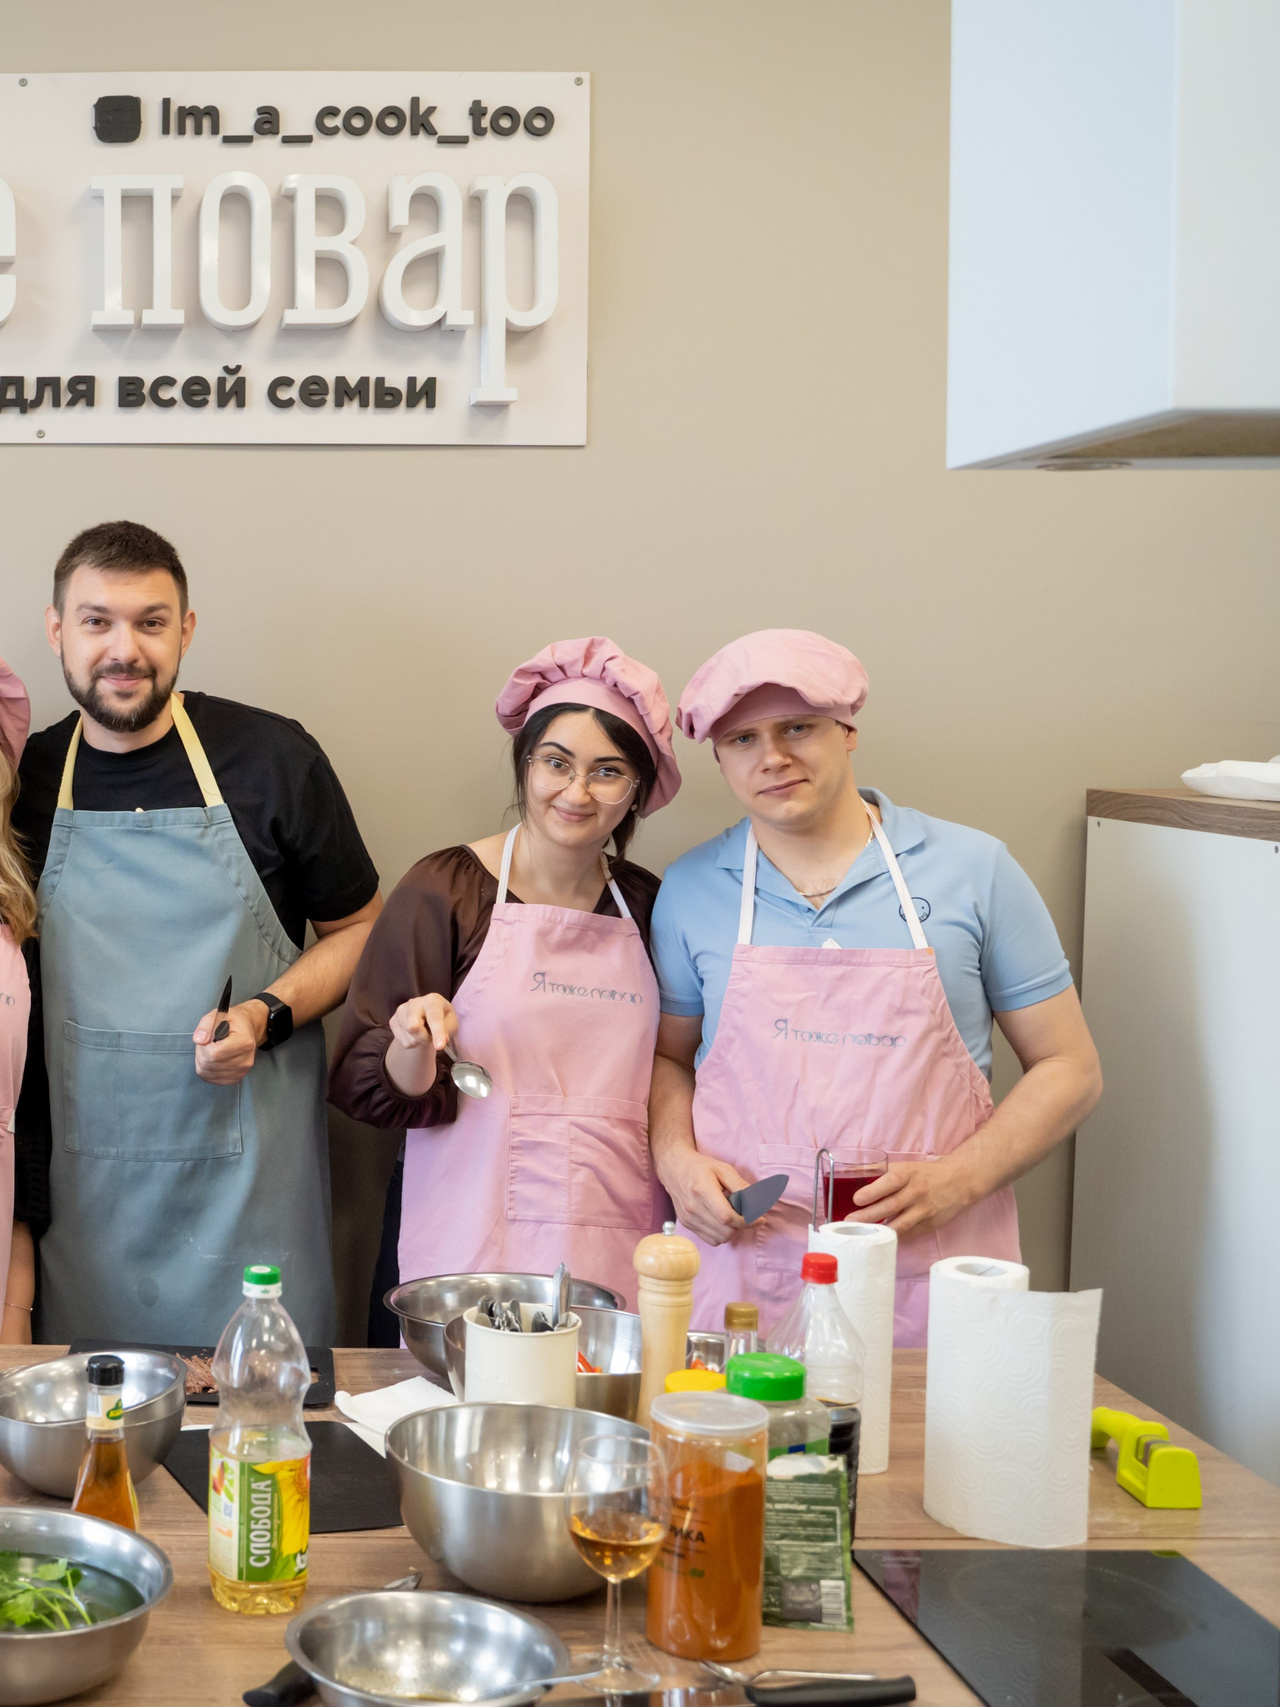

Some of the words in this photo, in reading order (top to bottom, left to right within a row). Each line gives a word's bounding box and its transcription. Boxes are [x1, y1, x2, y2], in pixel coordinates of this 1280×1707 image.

[90, 171, 559, 406] повар
[118, 365, 246, 409] всей
[267, 375, 437, 409] семьи
[530, 971, 546, 993] Я
[548, 982, 588, 998] тоже
[771, 1018, 788, 1040] Я
[790, 1029, 839, 1045] тоже
[842, 1033, 907, 1048] повар
[249, 1479, 272, 1568] СЛОБОДА
